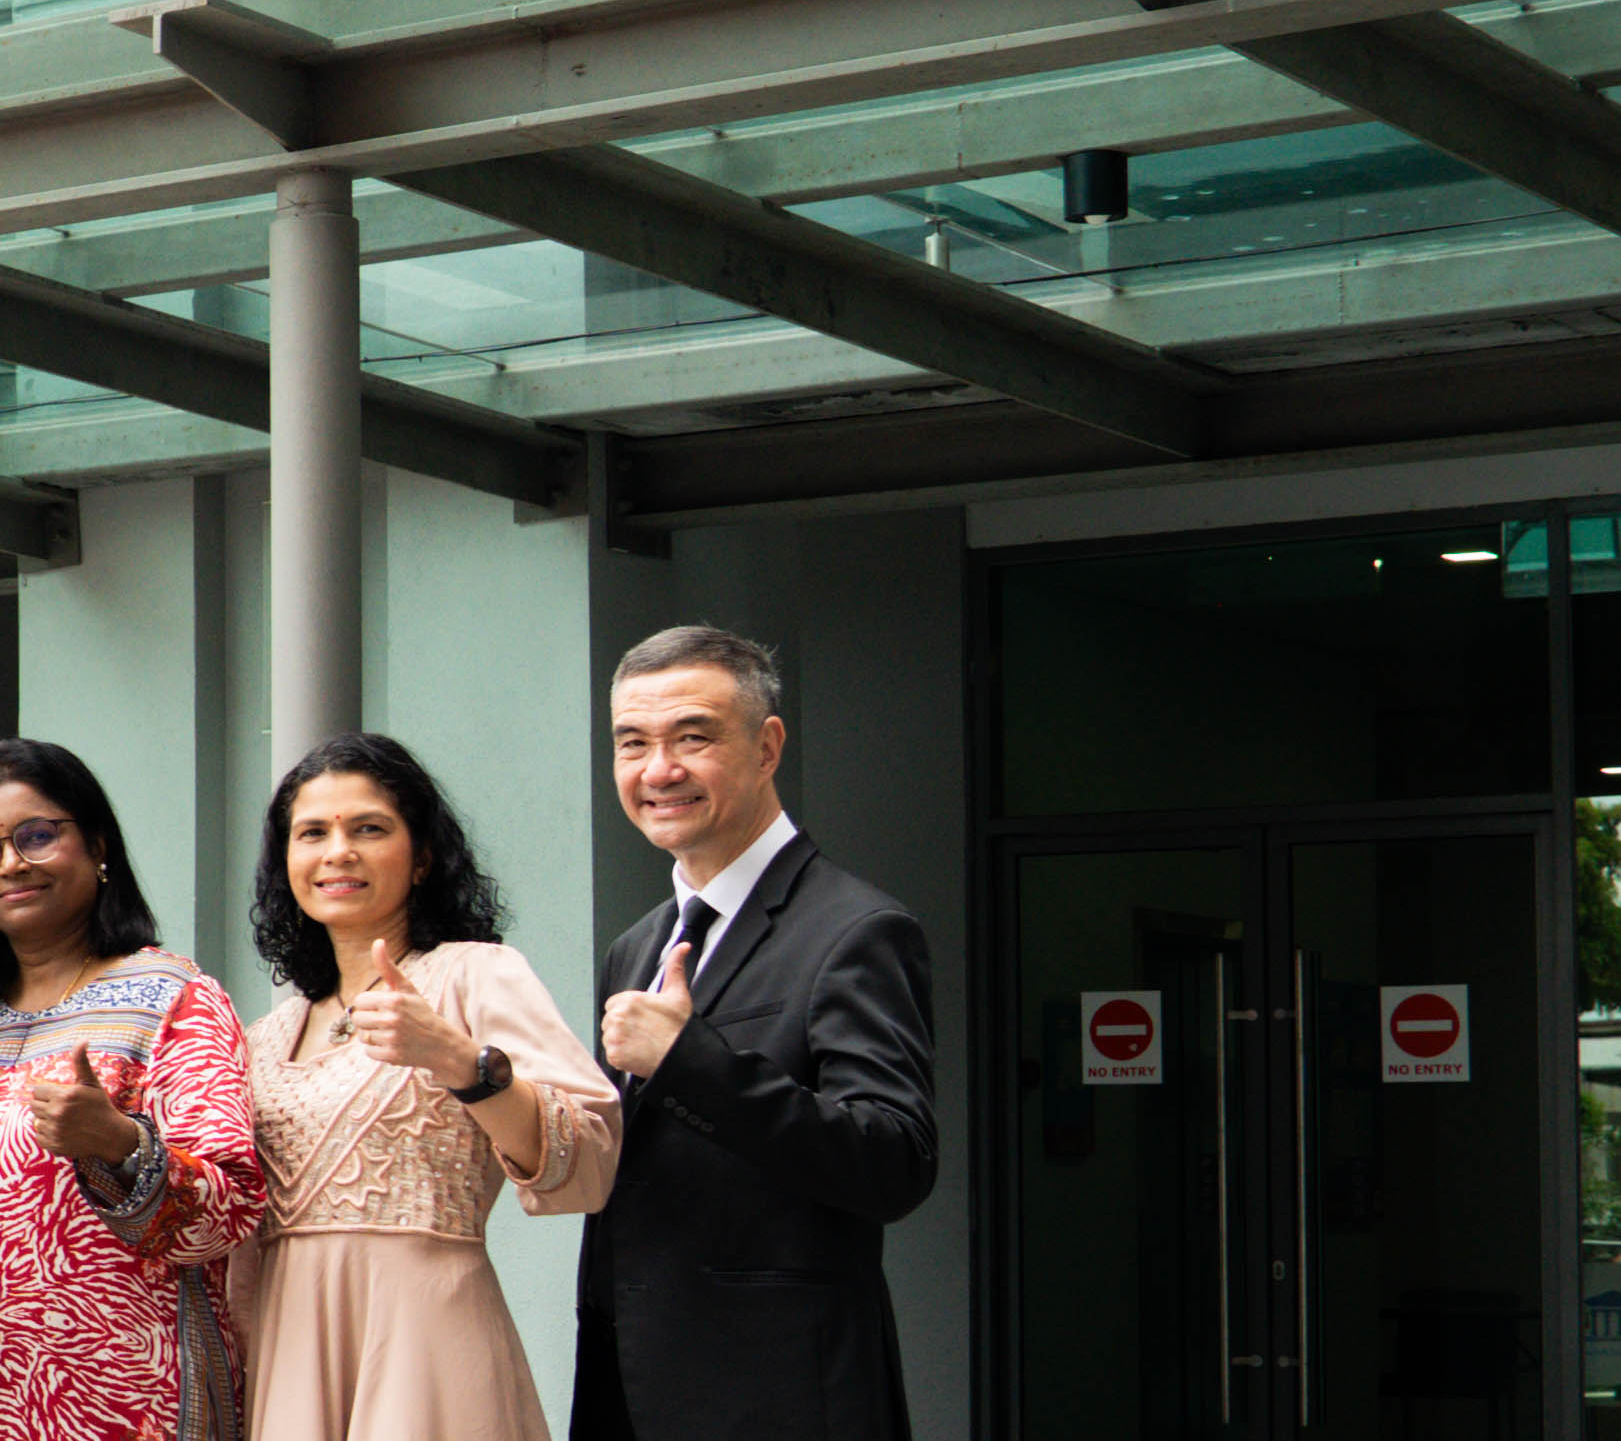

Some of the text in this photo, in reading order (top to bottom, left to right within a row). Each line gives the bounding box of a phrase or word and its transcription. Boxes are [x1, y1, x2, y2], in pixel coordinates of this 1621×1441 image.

[1088, 1066, 1157, 1078] NO ENTRY
[1388, 1063, 1463, 1076] NO ENTRY
